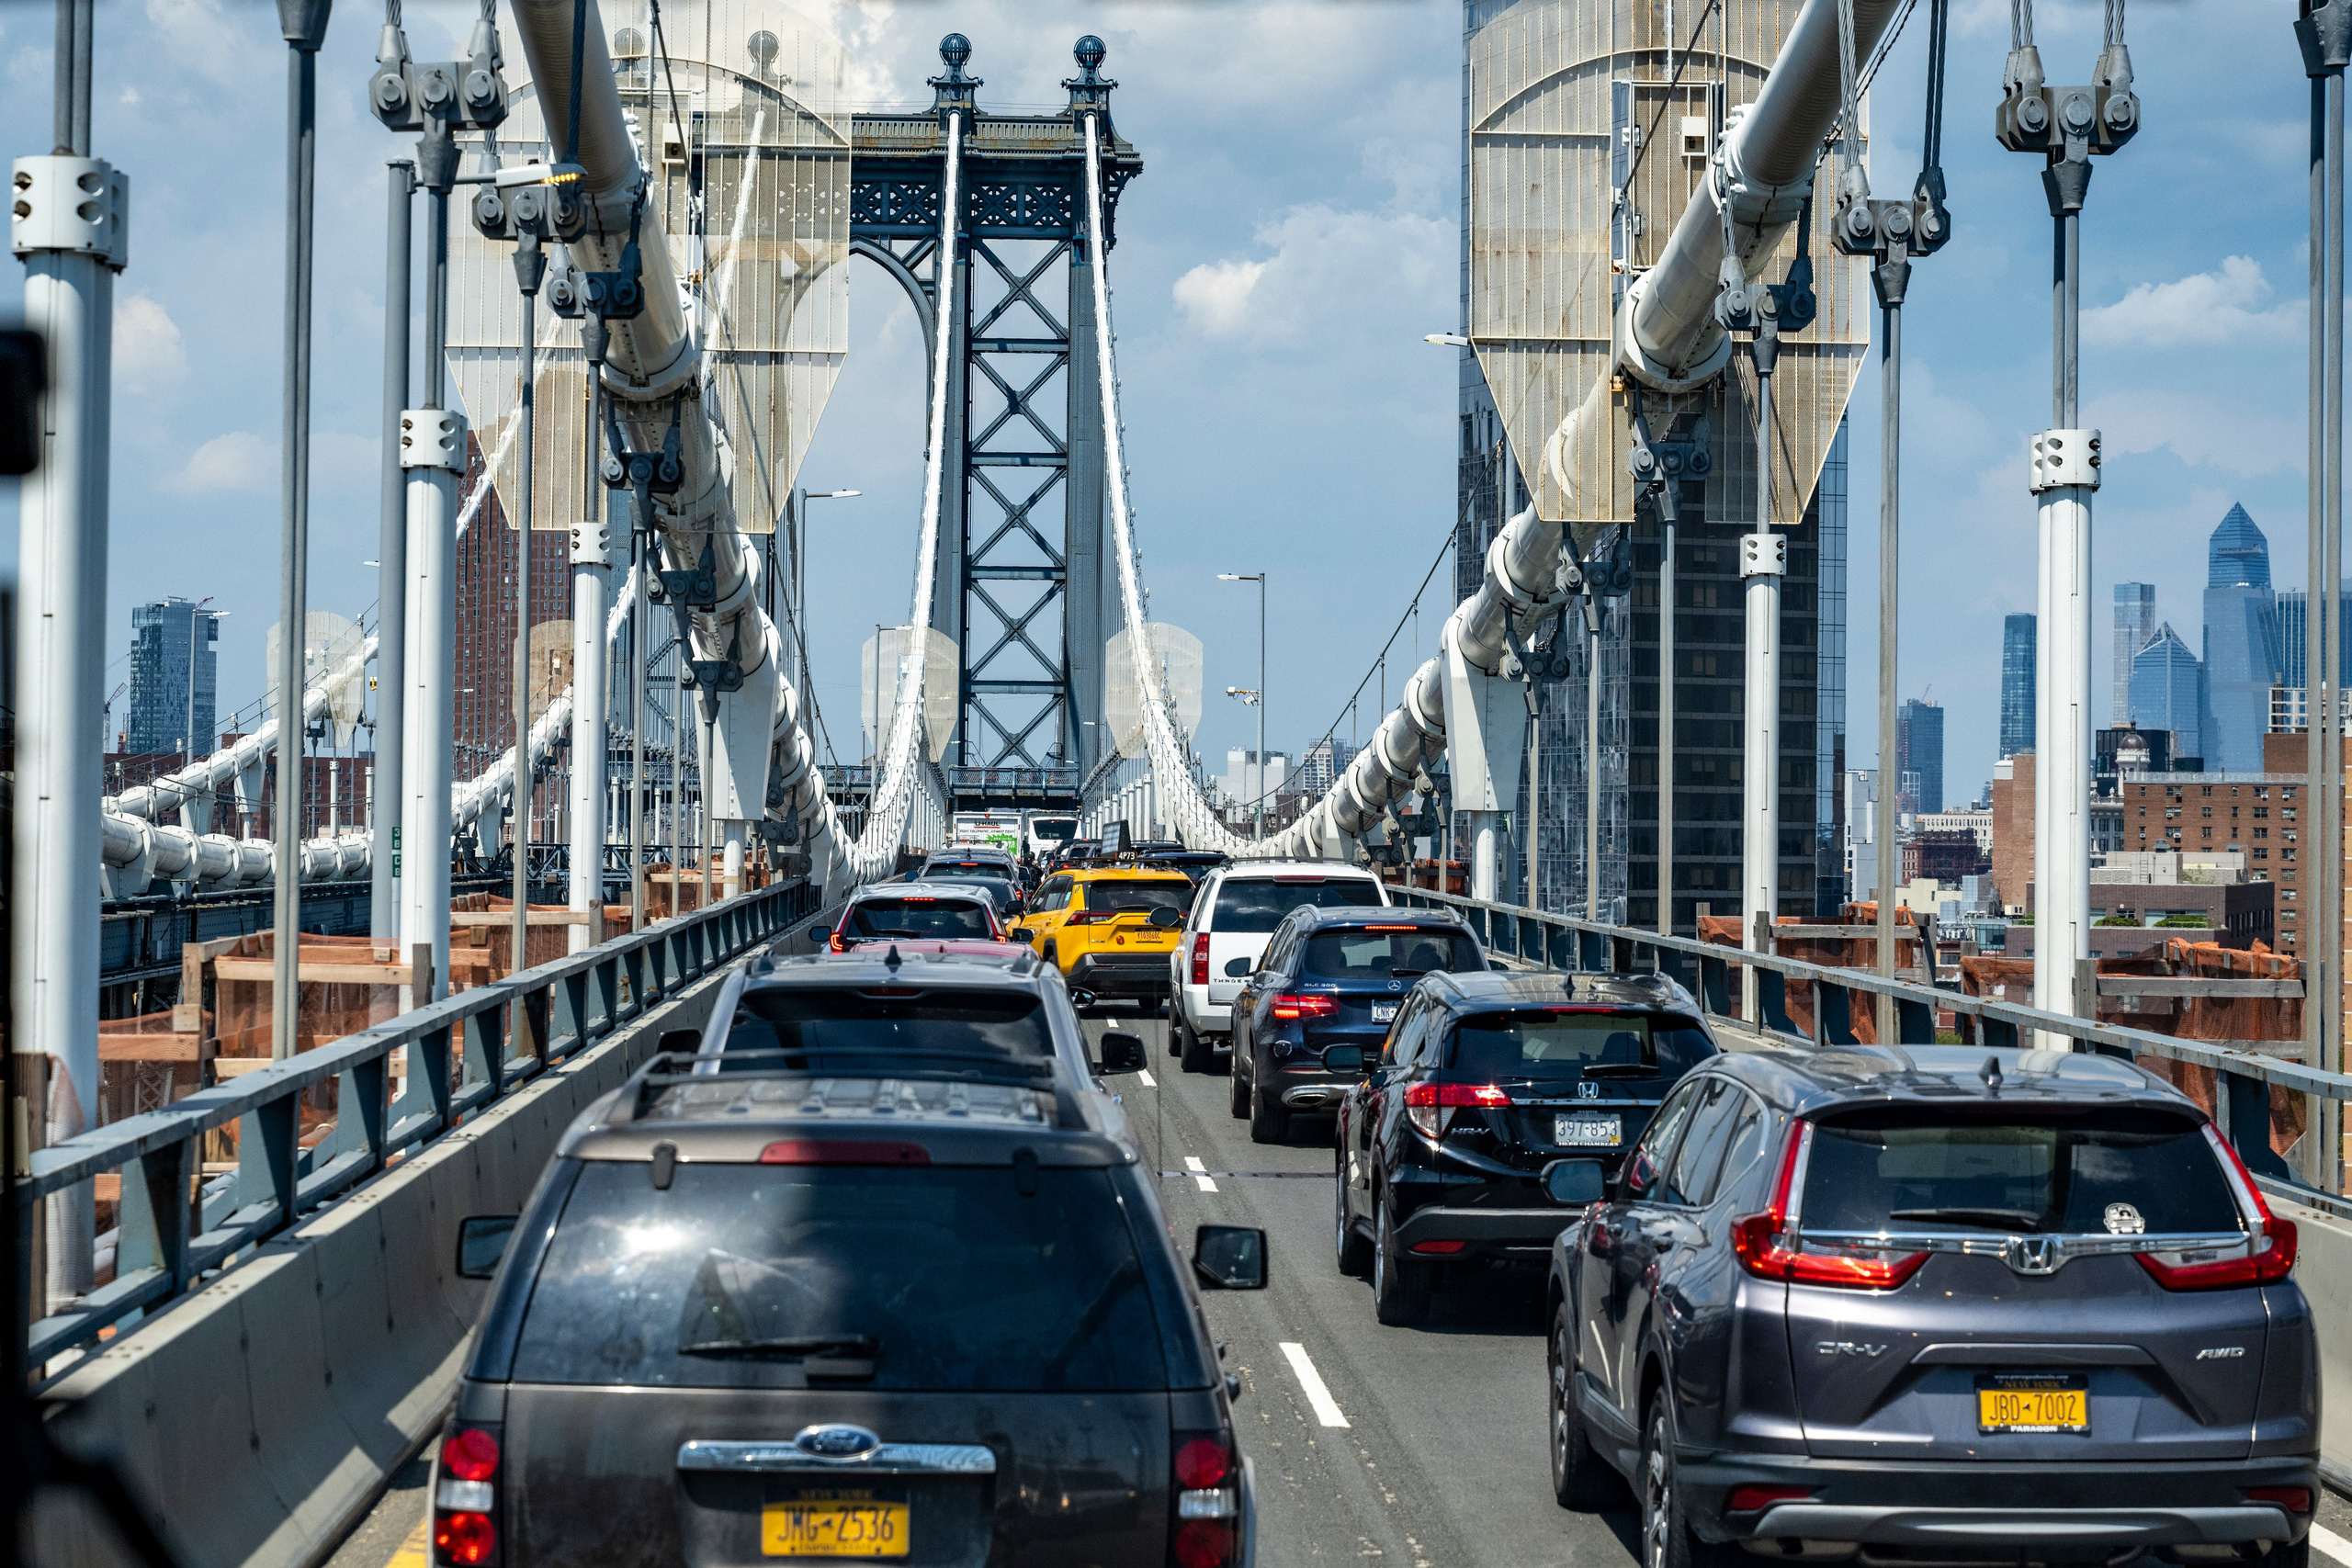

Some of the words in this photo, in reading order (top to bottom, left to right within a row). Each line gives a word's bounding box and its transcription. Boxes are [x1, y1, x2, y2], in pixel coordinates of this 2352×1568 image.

[1118, 852, 1136, 860] 4P73
[1557, 1121, 1617, 1136] 397-853
[1816, 1341, 1888, 1357] CR-V
[2196, 1347, 2245, 1359] AWD
[2005, 1381, 2030, 1389] NEW
[2033, 1381, 2061, 1389] YORK
[813, 1430, 861, 1450] Ford
